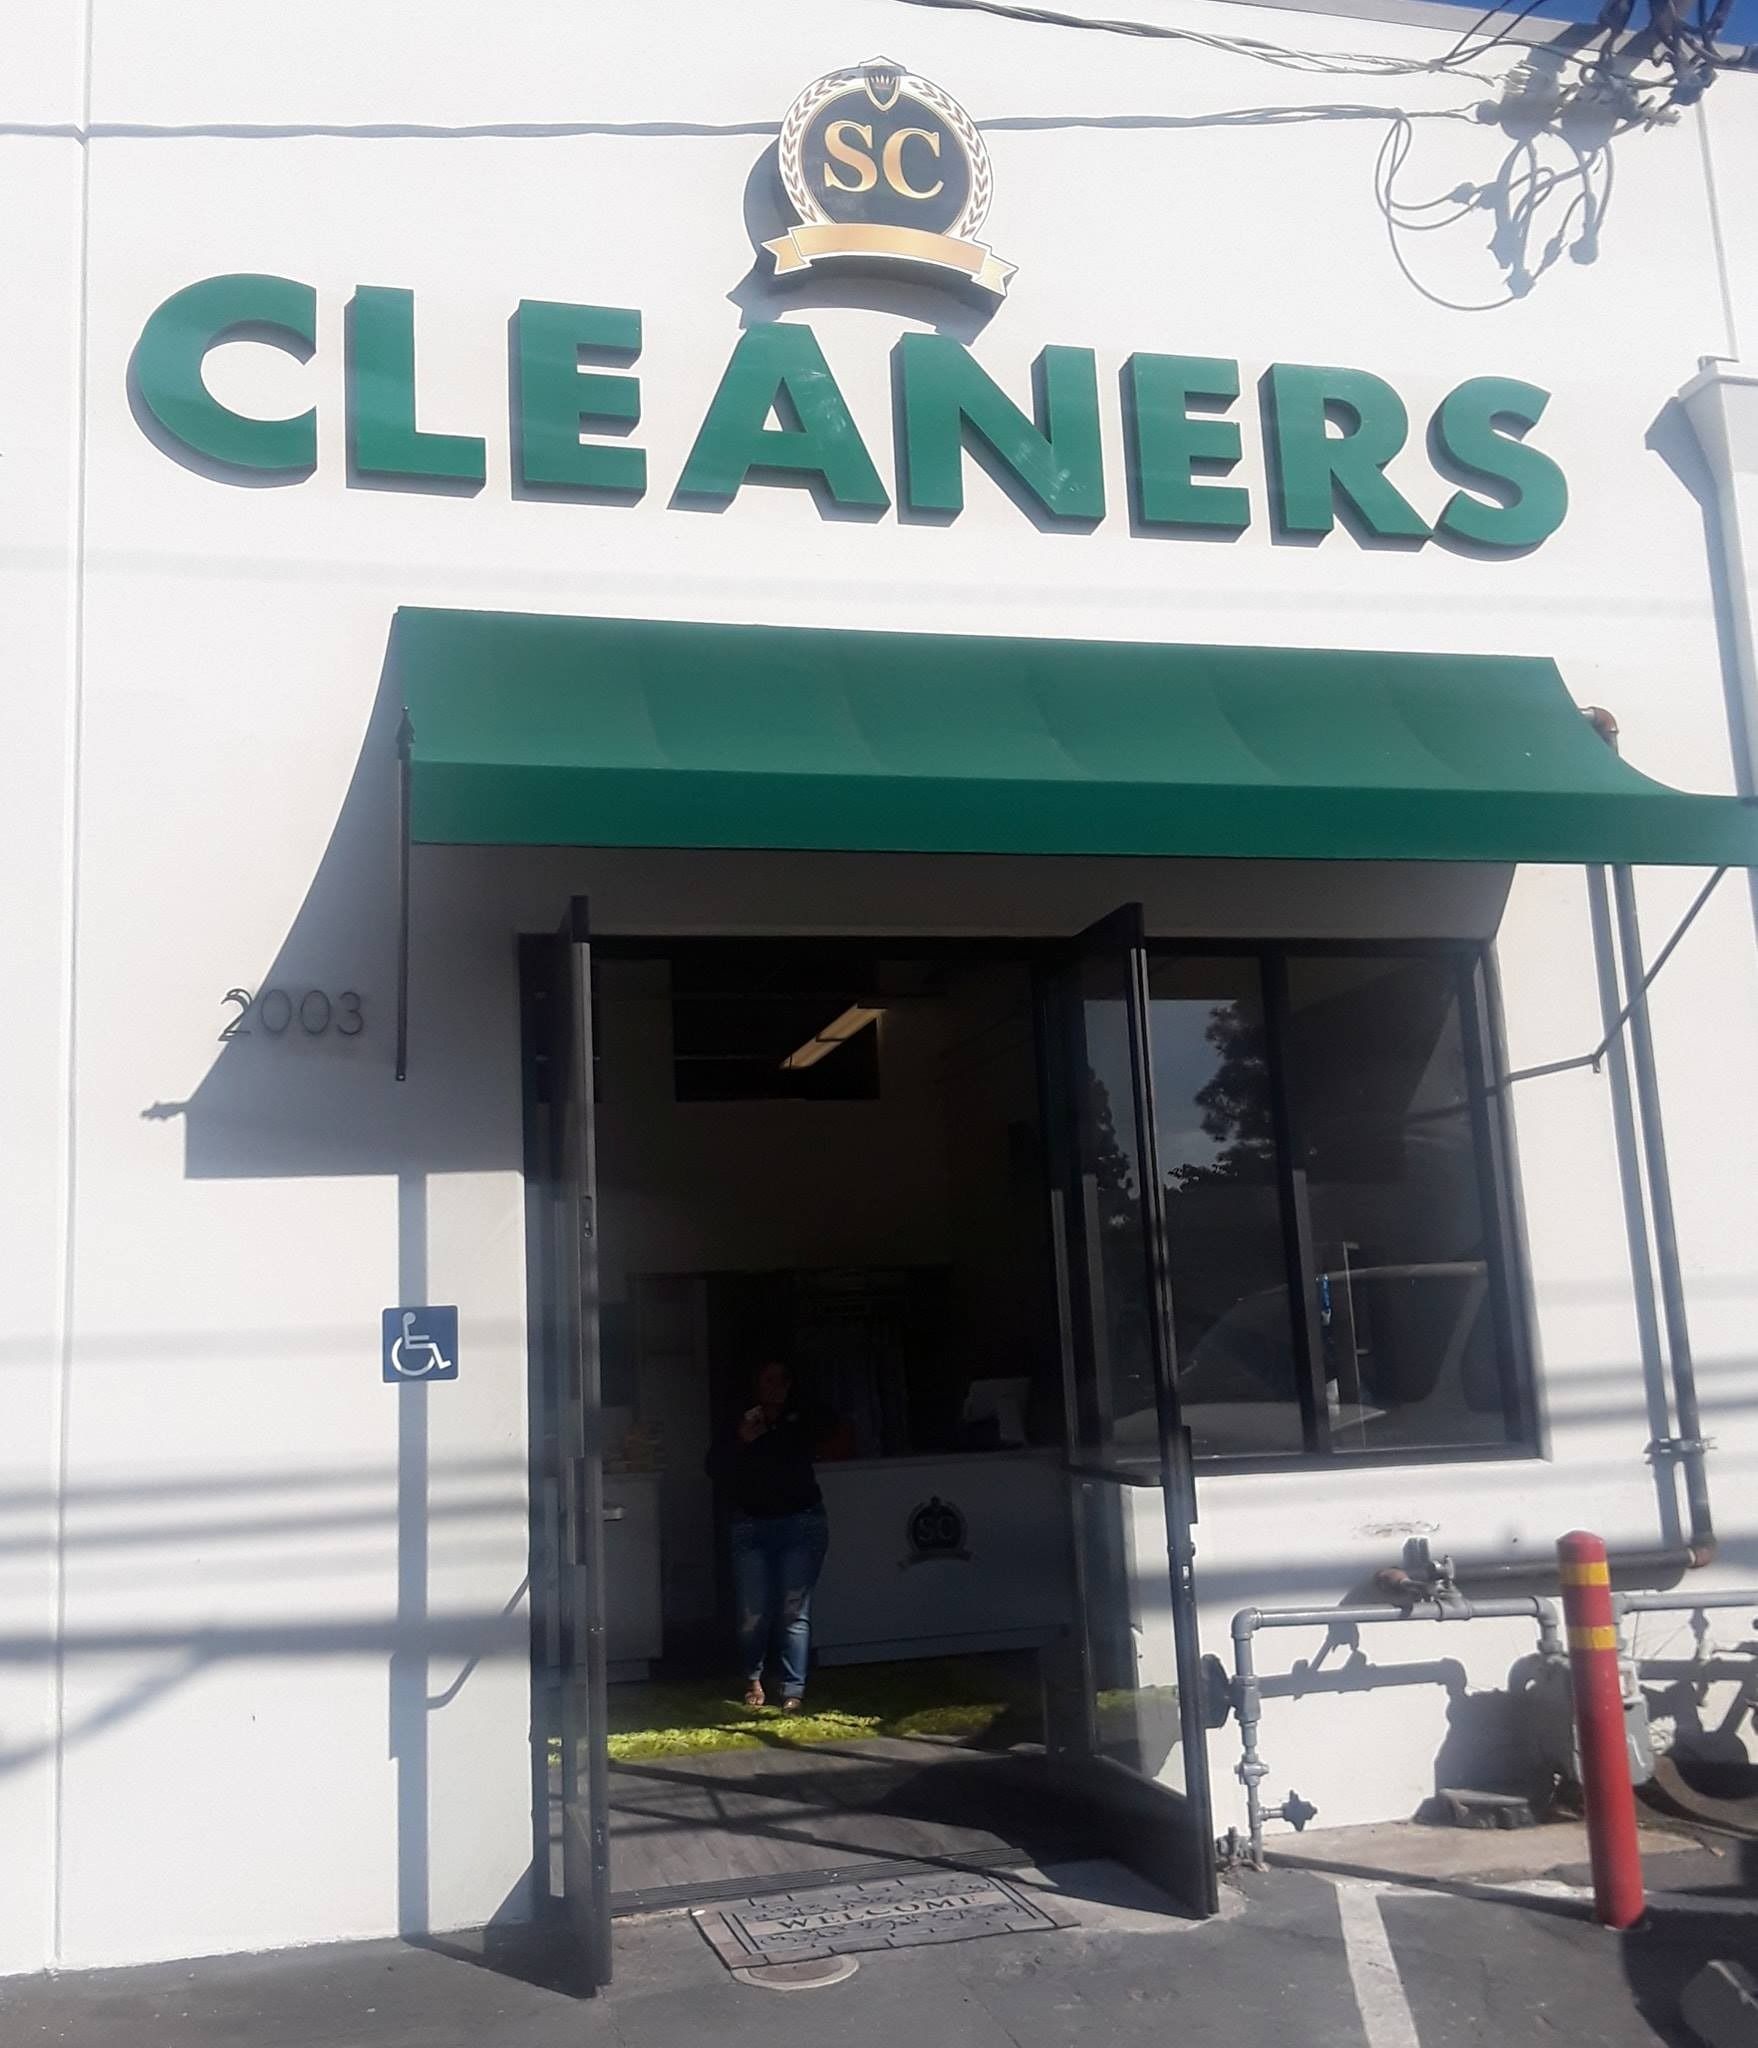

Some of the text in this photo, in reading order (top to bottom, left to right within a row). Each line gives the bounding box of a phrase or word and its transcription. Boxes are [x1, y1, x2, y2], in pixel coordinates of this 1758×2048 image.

[823, 120, 945, 200] SC
[129, 273, 1567, 562] CLEANERS
[220, 988, 364, 1037] 2003
[779, 1896, 982, 1930] WELCOME
